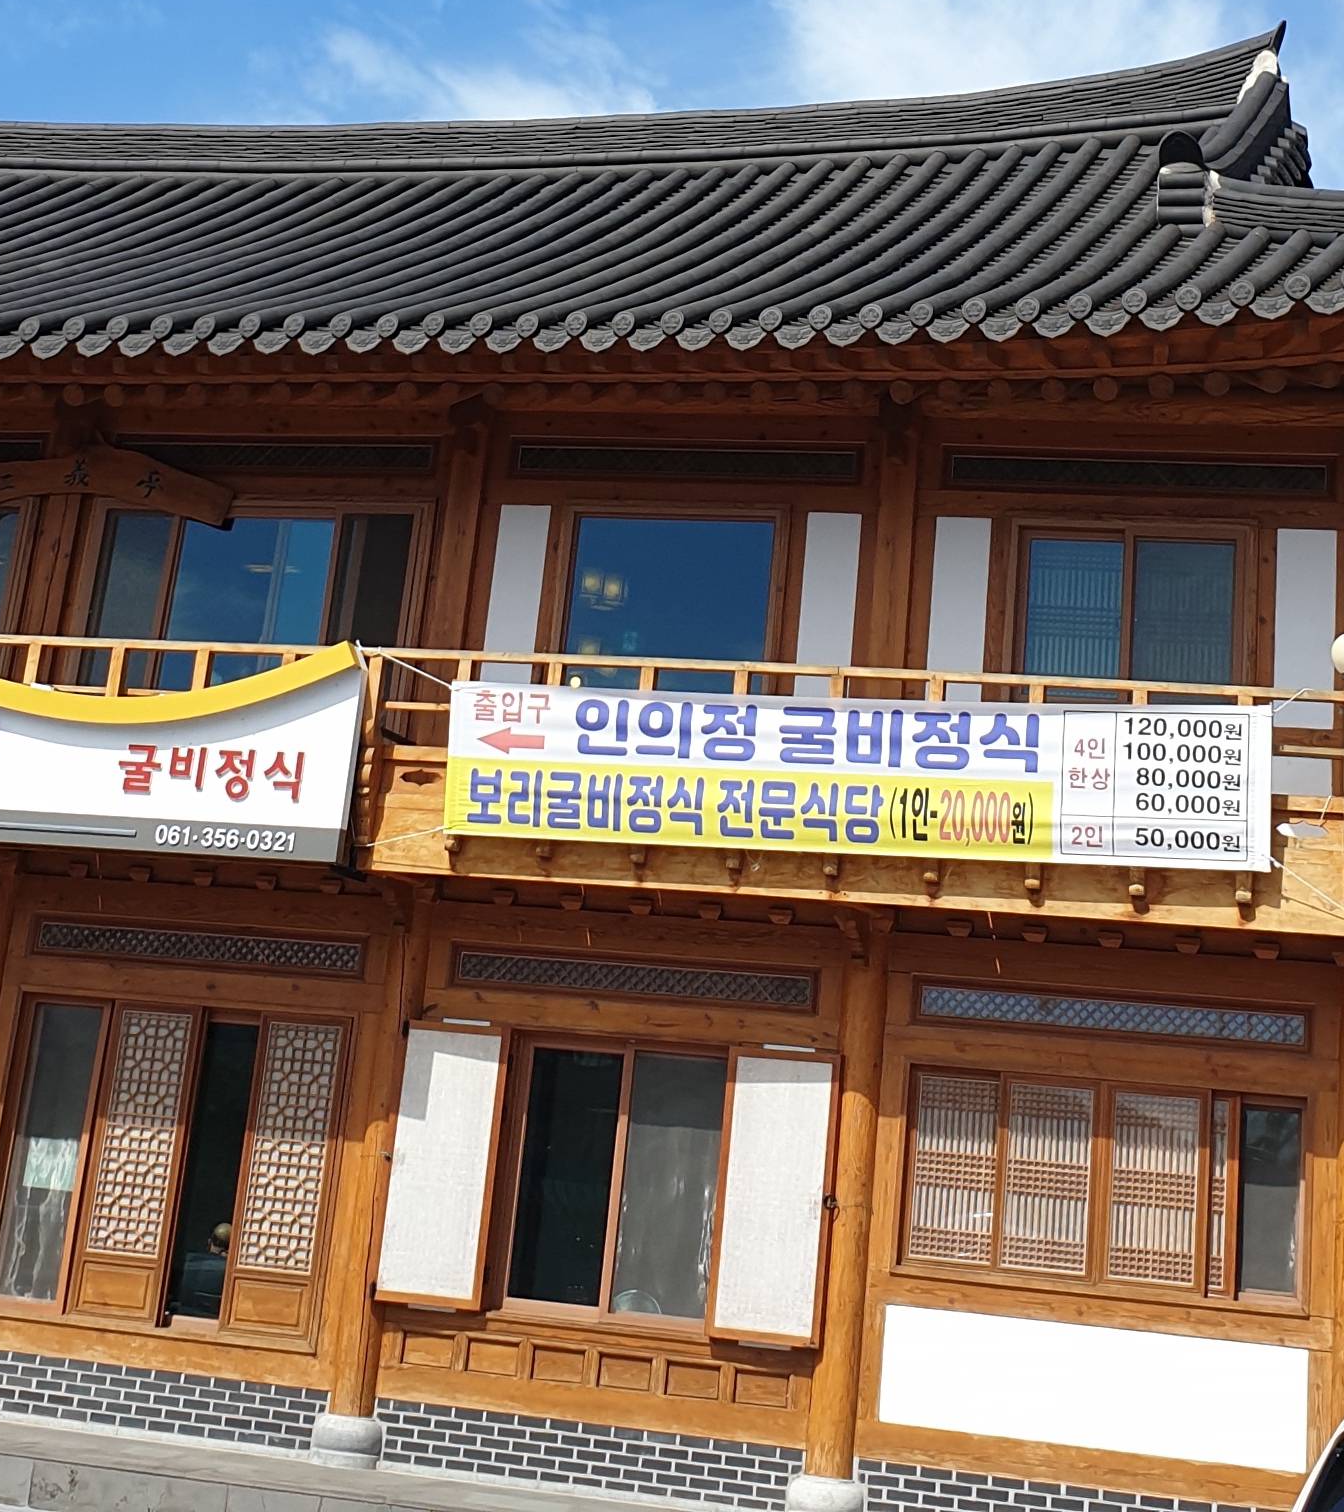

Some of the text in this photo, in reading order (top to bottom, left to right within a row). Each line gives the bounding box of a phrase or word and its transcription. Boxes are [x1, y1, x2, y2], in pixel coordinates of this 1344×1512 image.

[473, 690, 551, 725] 출입구
[575, 698, 1040, 774] 인의정 굴비정식
[1124, 717, 1243, 740] 120,000원
[1074, 737, 1106, 760] 4인
[1123, 742, 1242, 766] 100,000원
[118, 744, 306, 804] 굴비정식
[1068, 767, 1111, 791] 한상
[1135, 767, 1241, 791] 80,000원
[466, 768, 706, 836] 보리굴비정식
[716, 778, 885, 844] 전문식당
[1135, 793, 1241, 817] 60,000원
[1071, 825, 1103, 848] 2인
[1134, 827, 1241, 853] 50,000원
